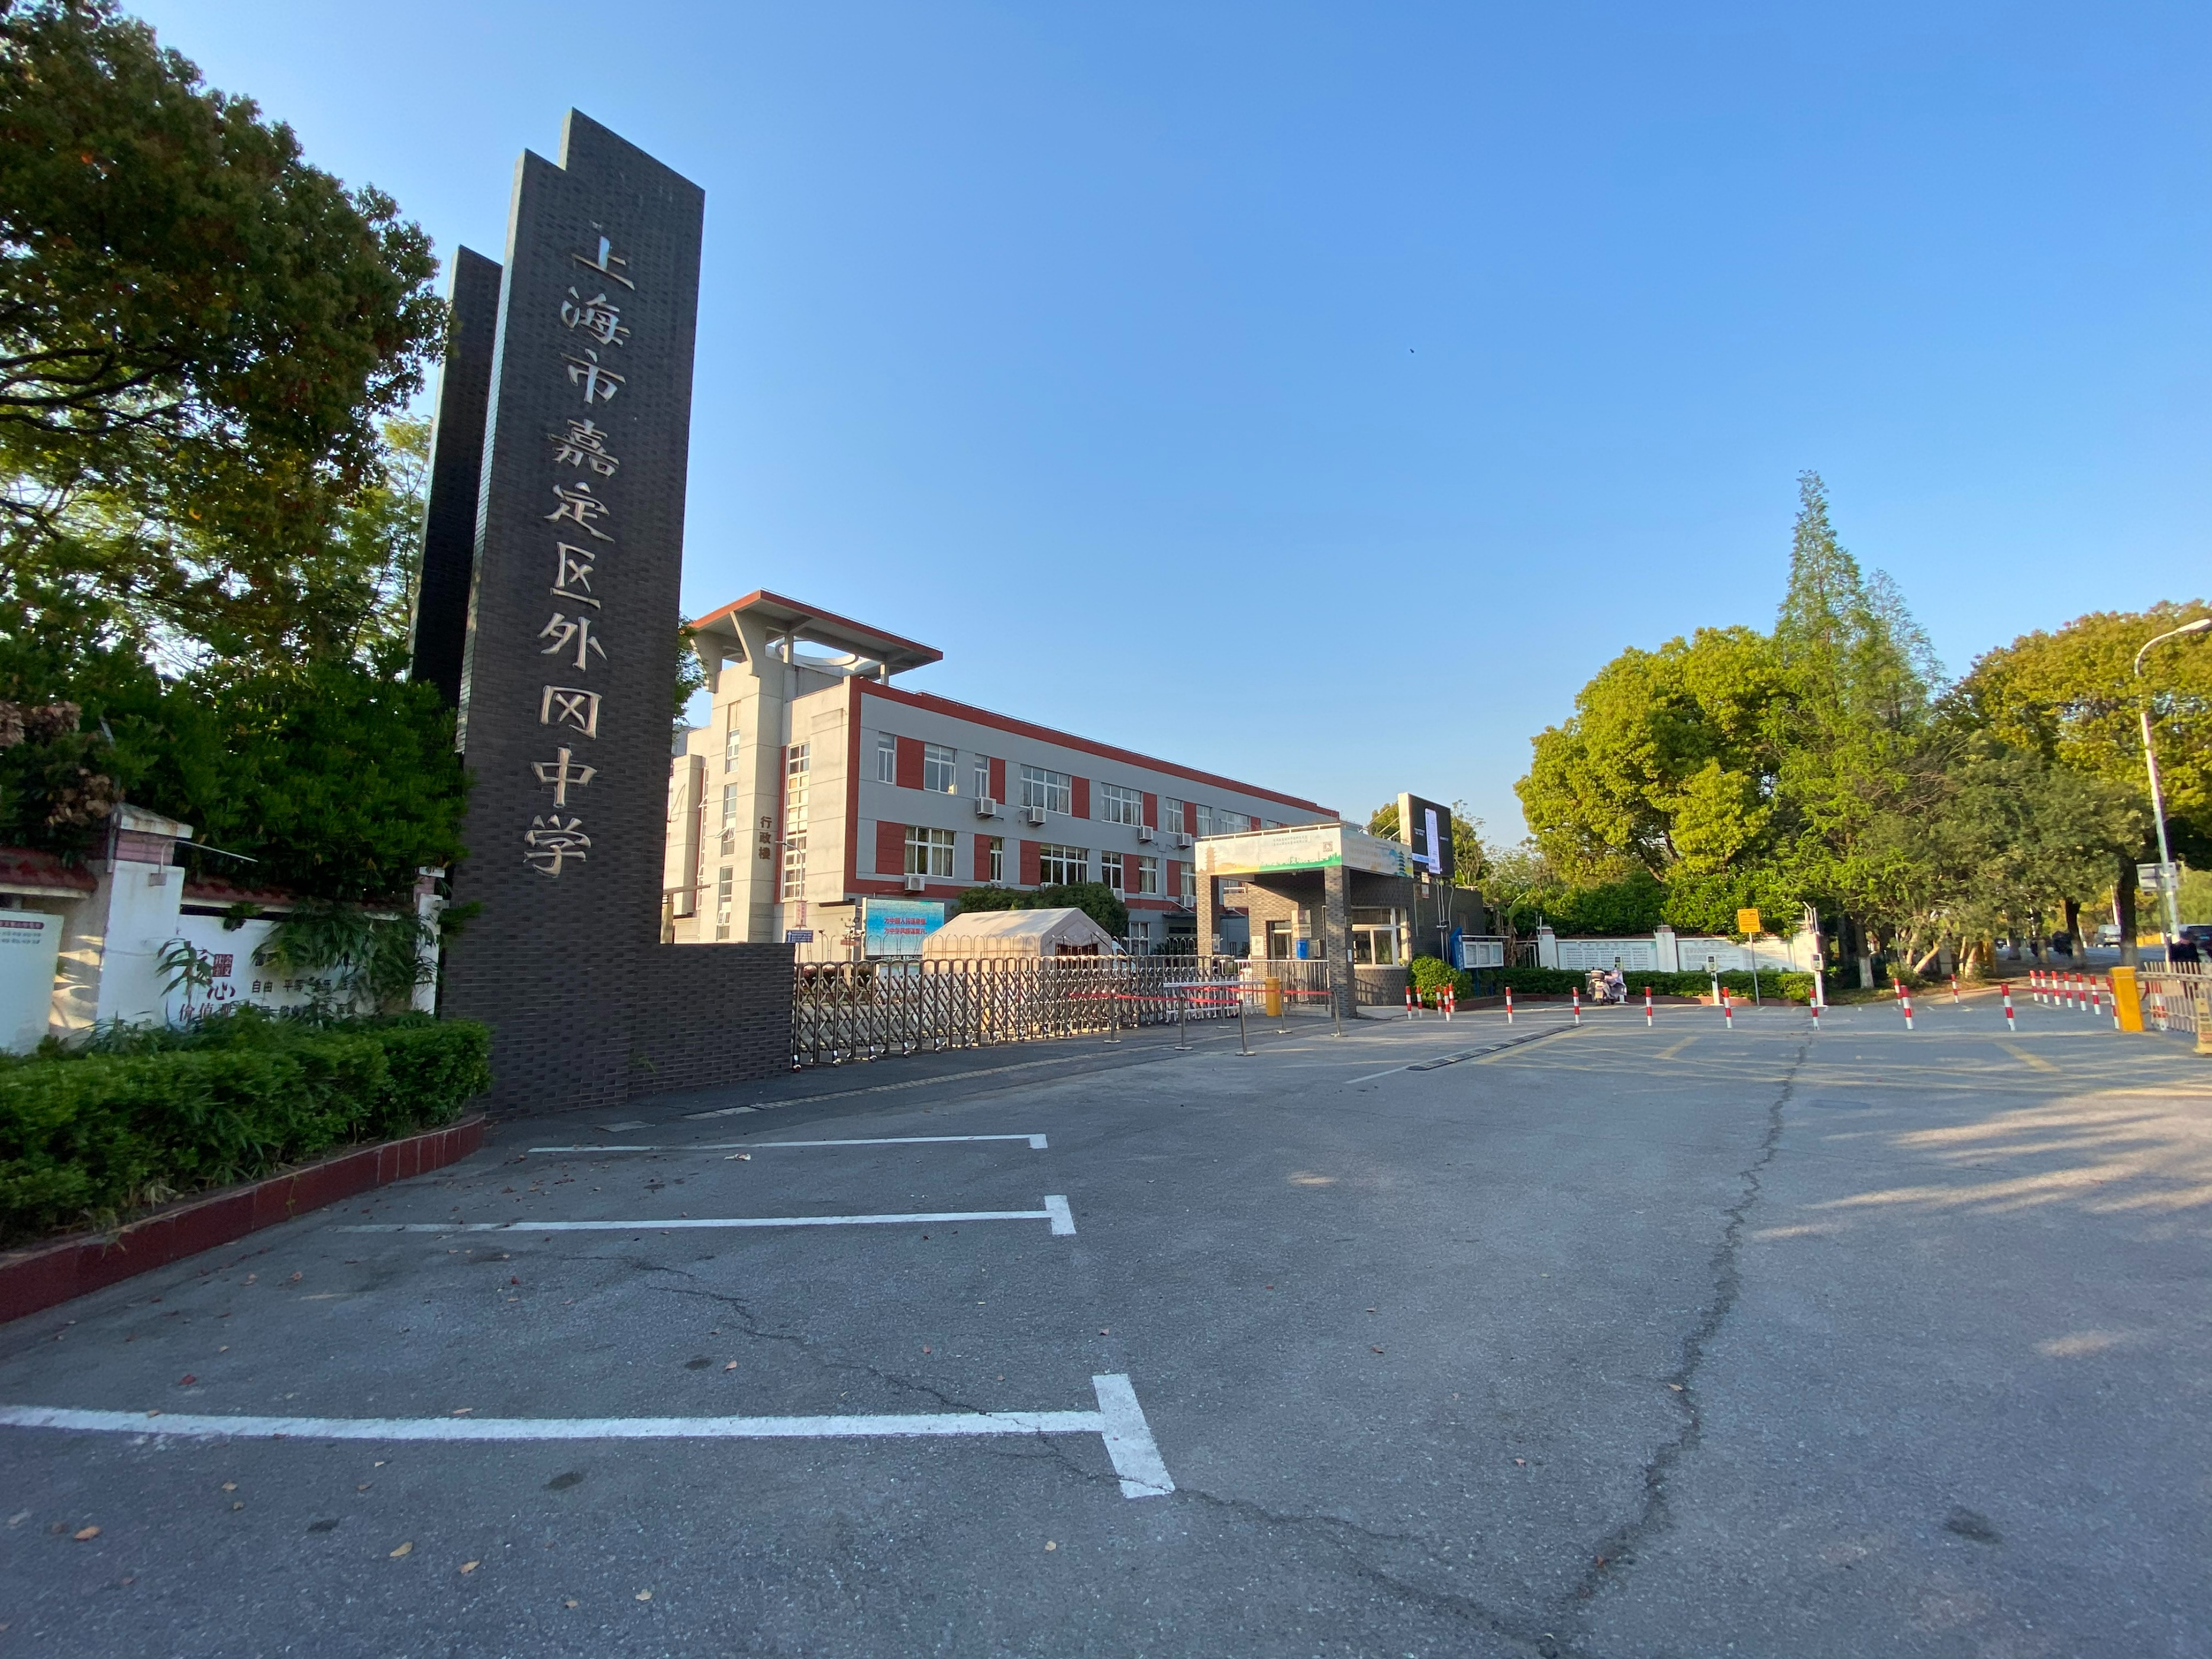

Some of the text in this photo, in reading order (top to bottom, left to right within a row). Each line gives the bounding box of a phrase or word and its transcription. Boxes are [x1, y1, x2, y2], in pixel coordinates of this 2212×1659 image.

[524, 236, 635, 878] 上海市嘉定区外冈中学
[758, 815, 773, 860] 行政楼
[253, 980, 273, 993] 自由
